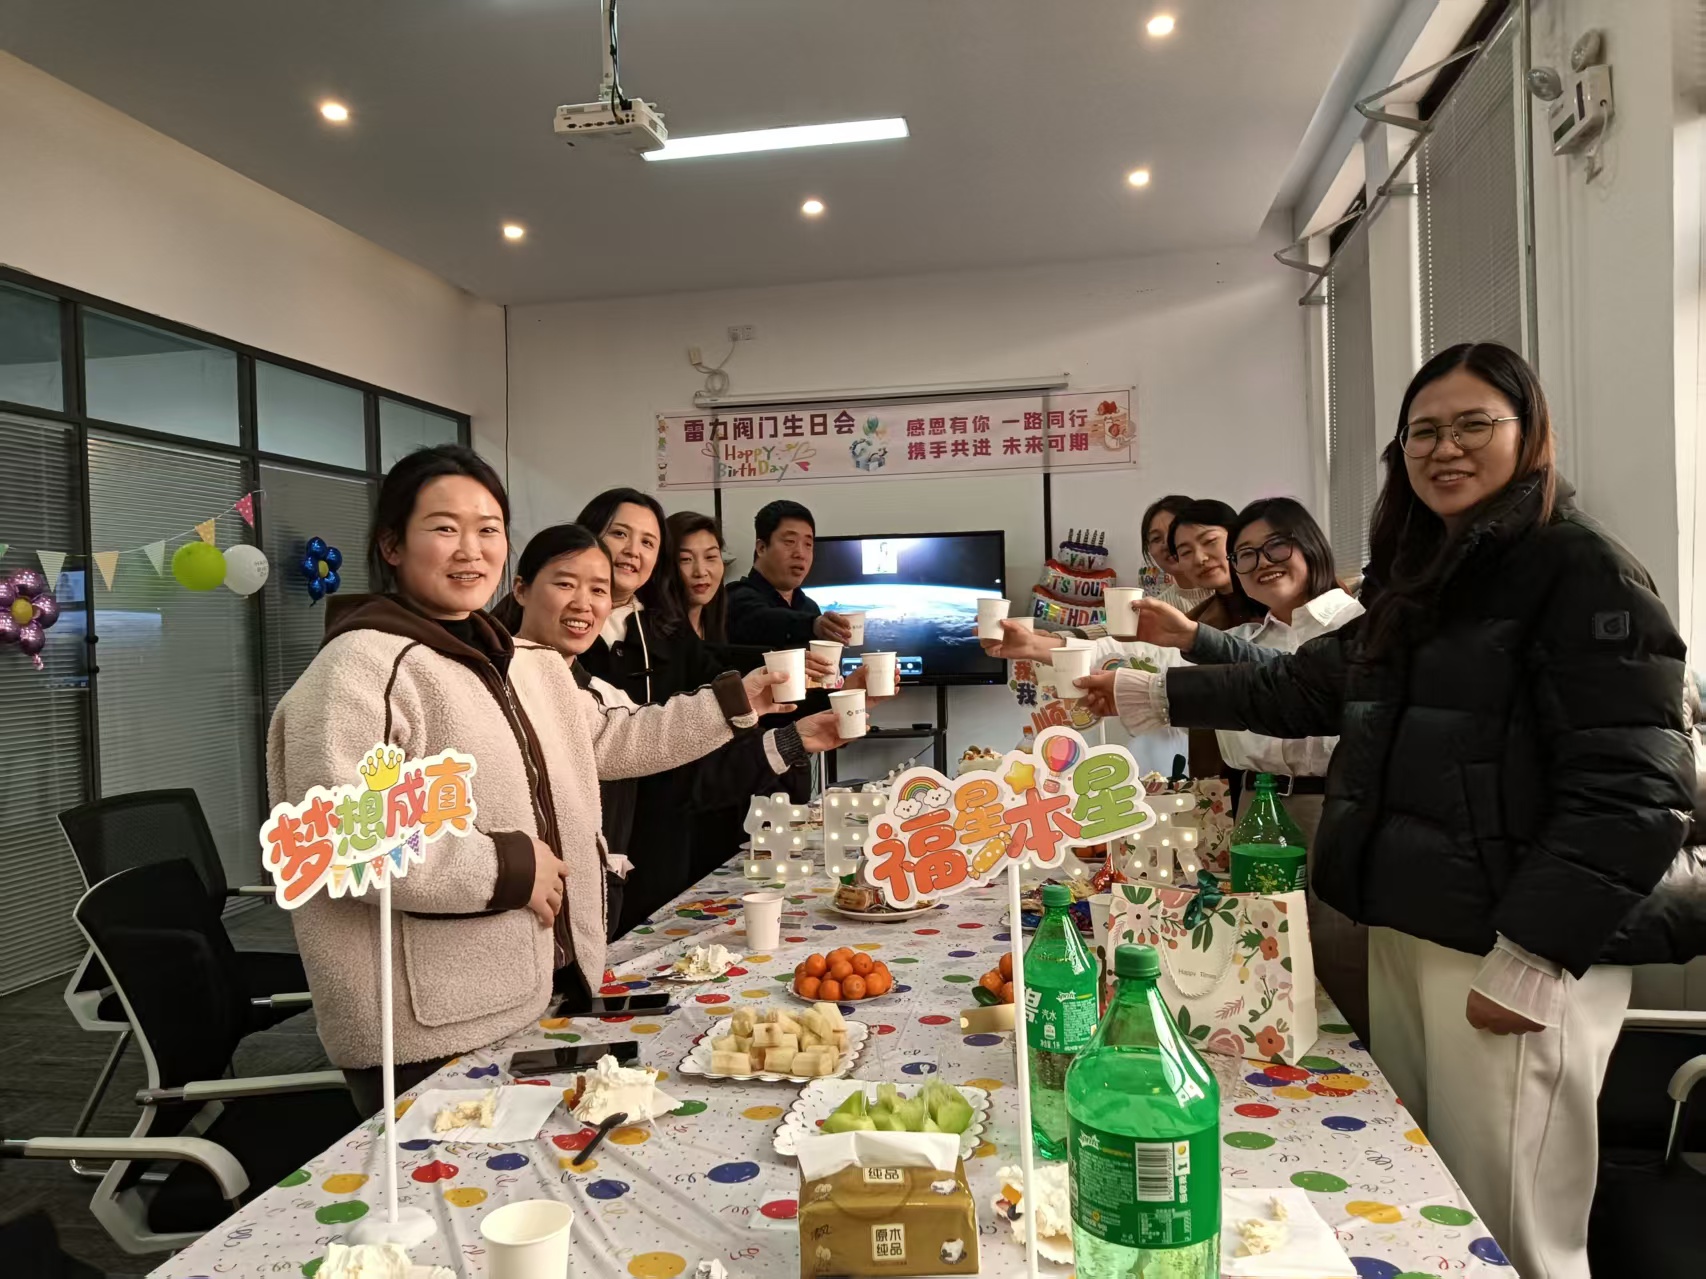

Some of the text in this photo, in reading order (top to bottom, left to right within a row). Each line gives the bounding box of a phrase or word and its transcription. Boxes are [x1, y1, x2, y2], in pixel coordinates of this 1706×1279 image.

[684, 410, 856, 442] 雷力阀门生日会
[906, 409, 1088, 437] 感恩有你 一路同行
[907, 433, 1089, 460] 携手共进 未来可期
[1070, 553, 1096, 569] YAY
[267, 756, 472, 901] 梦想成真
[875, 1227, 902, 1242] 原木
[876, 1242, 903, 1257] 纯品
